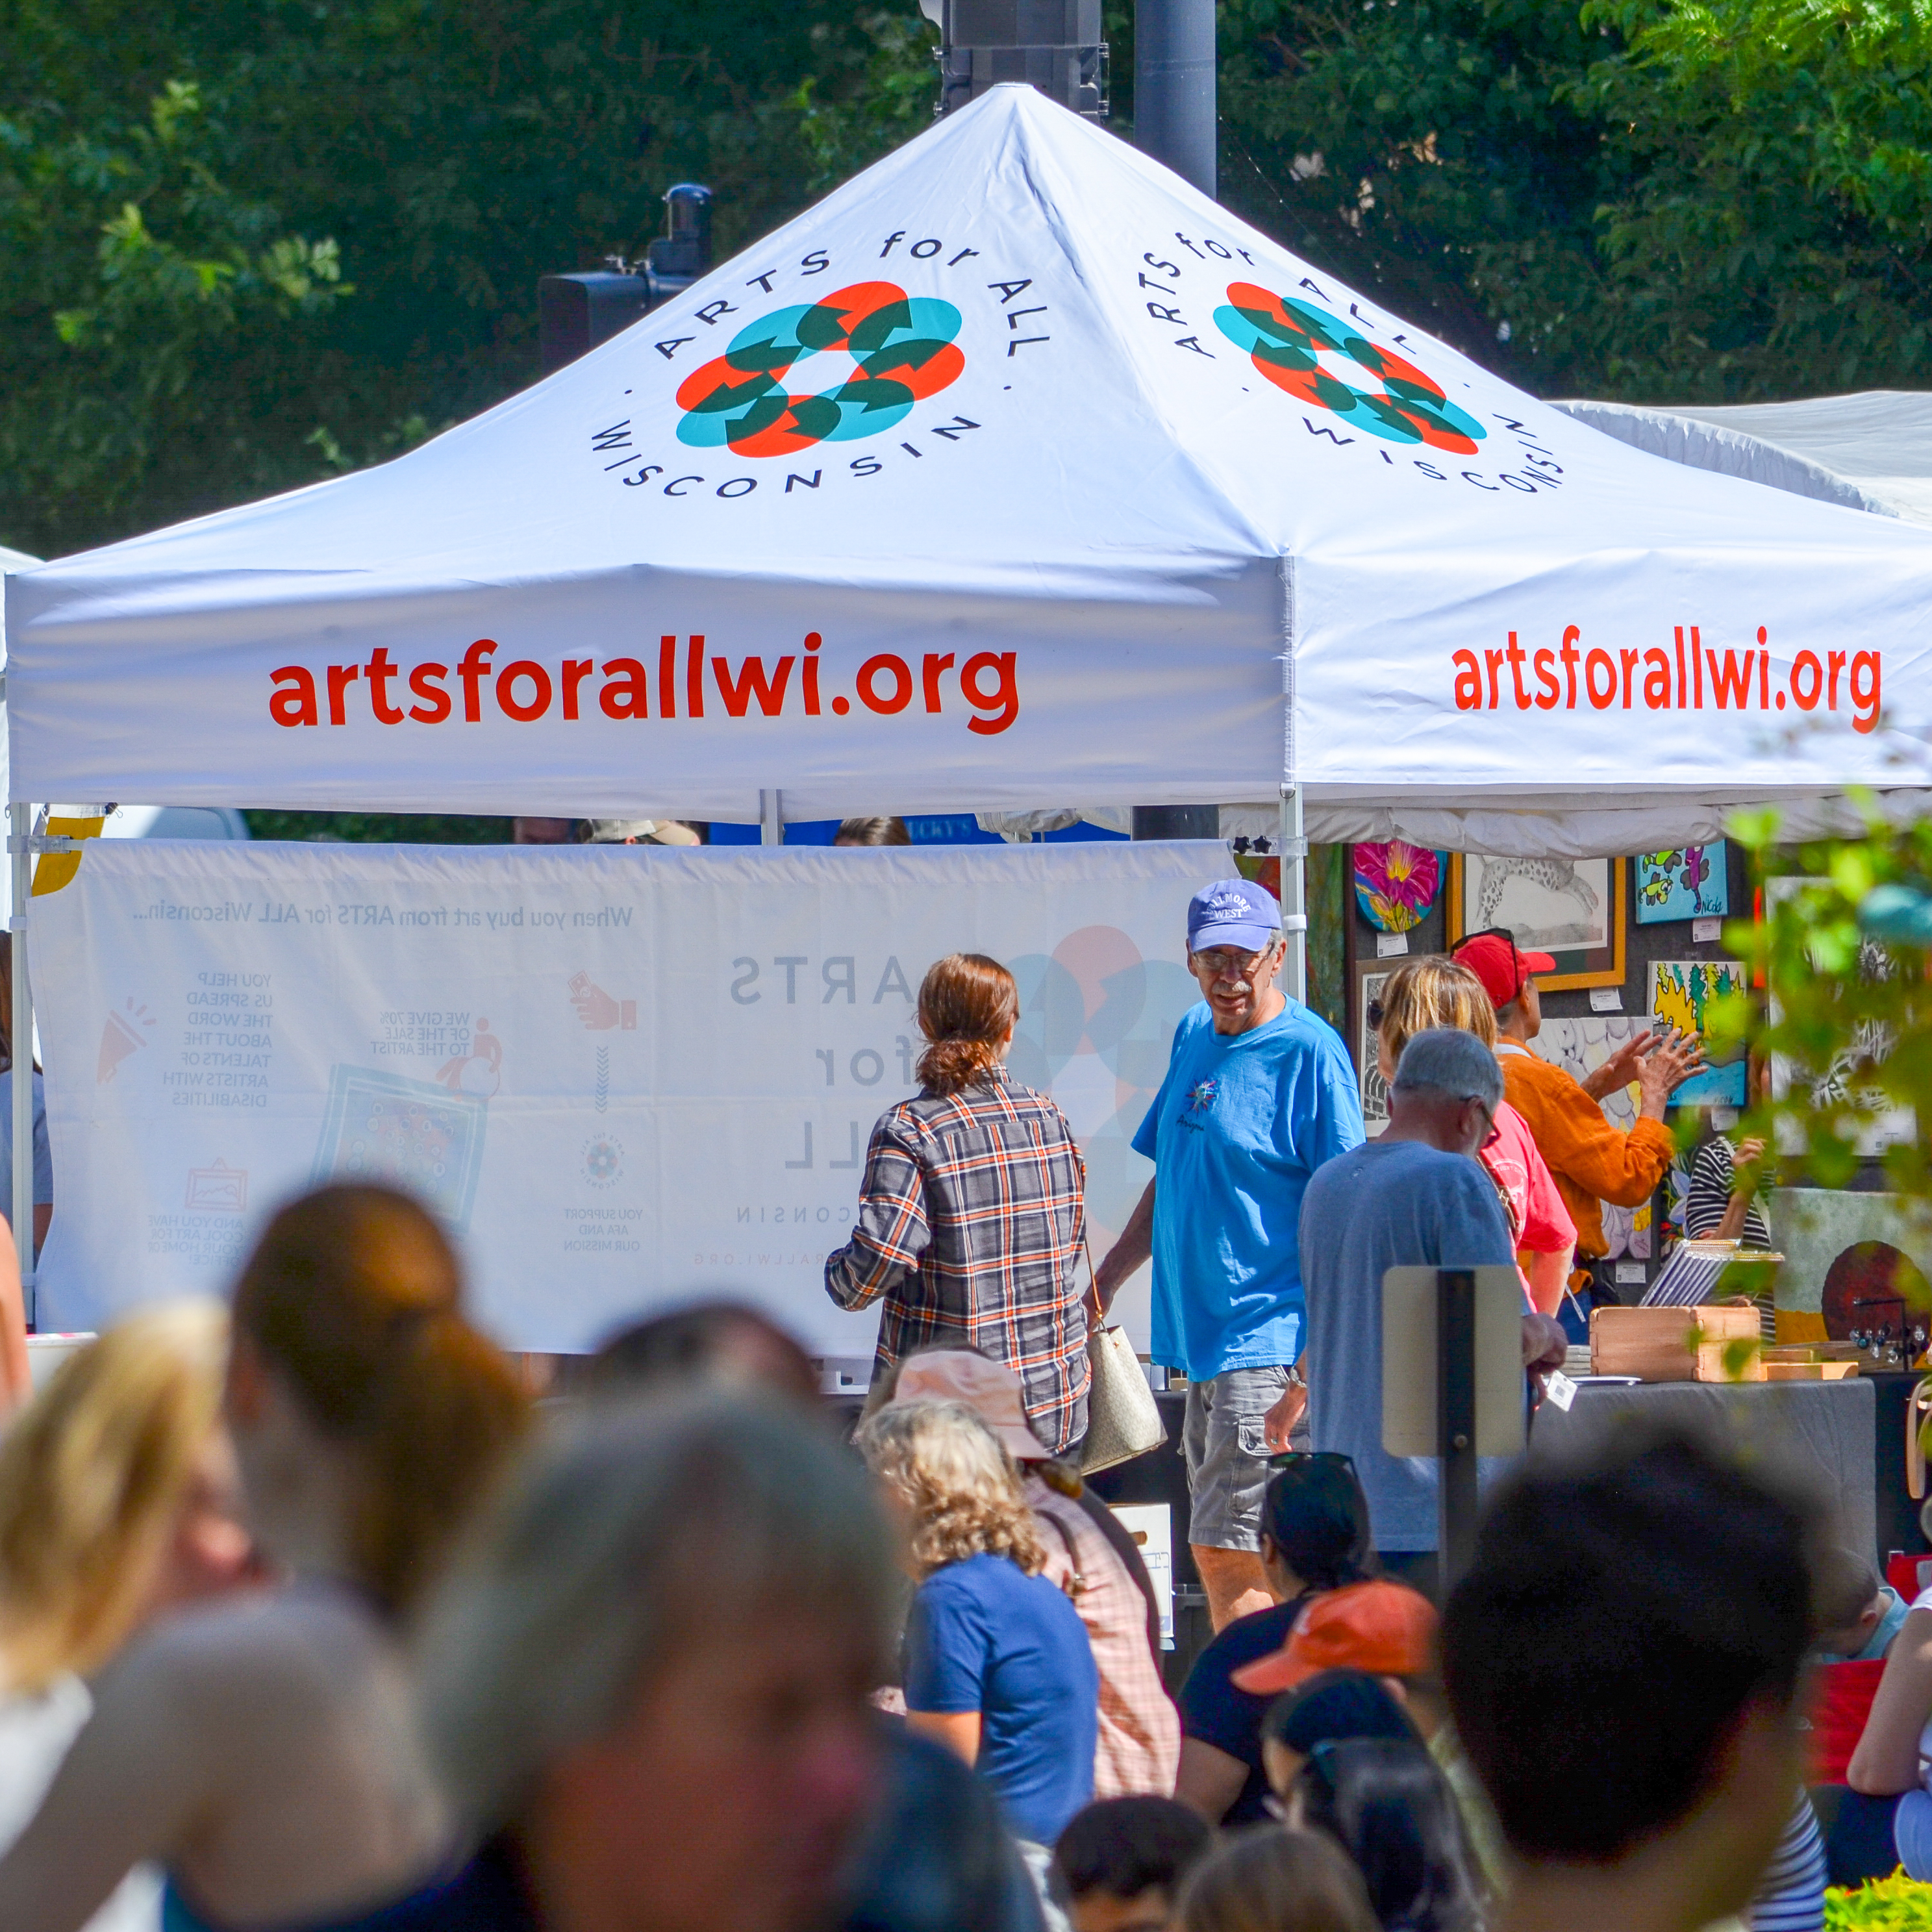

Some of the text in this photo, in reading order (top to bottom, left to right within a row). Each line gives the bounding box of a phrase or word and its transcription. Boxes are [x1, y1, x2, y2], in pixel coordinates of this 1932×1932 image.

[653, 231, 1050, 360] ARTS for ALL
[1138, 232, 1417, 359] ARTS for ALL
[592, 416, 982, 499] WISCONSIN
[1301, 413, 1564, 494] WISCONSIN
[268, 631, 1020, 736] artsforallwi.org
[1451, 624, 1881, 734] artsforallwi.org
[1214, 909, 1243, 919] WEST
